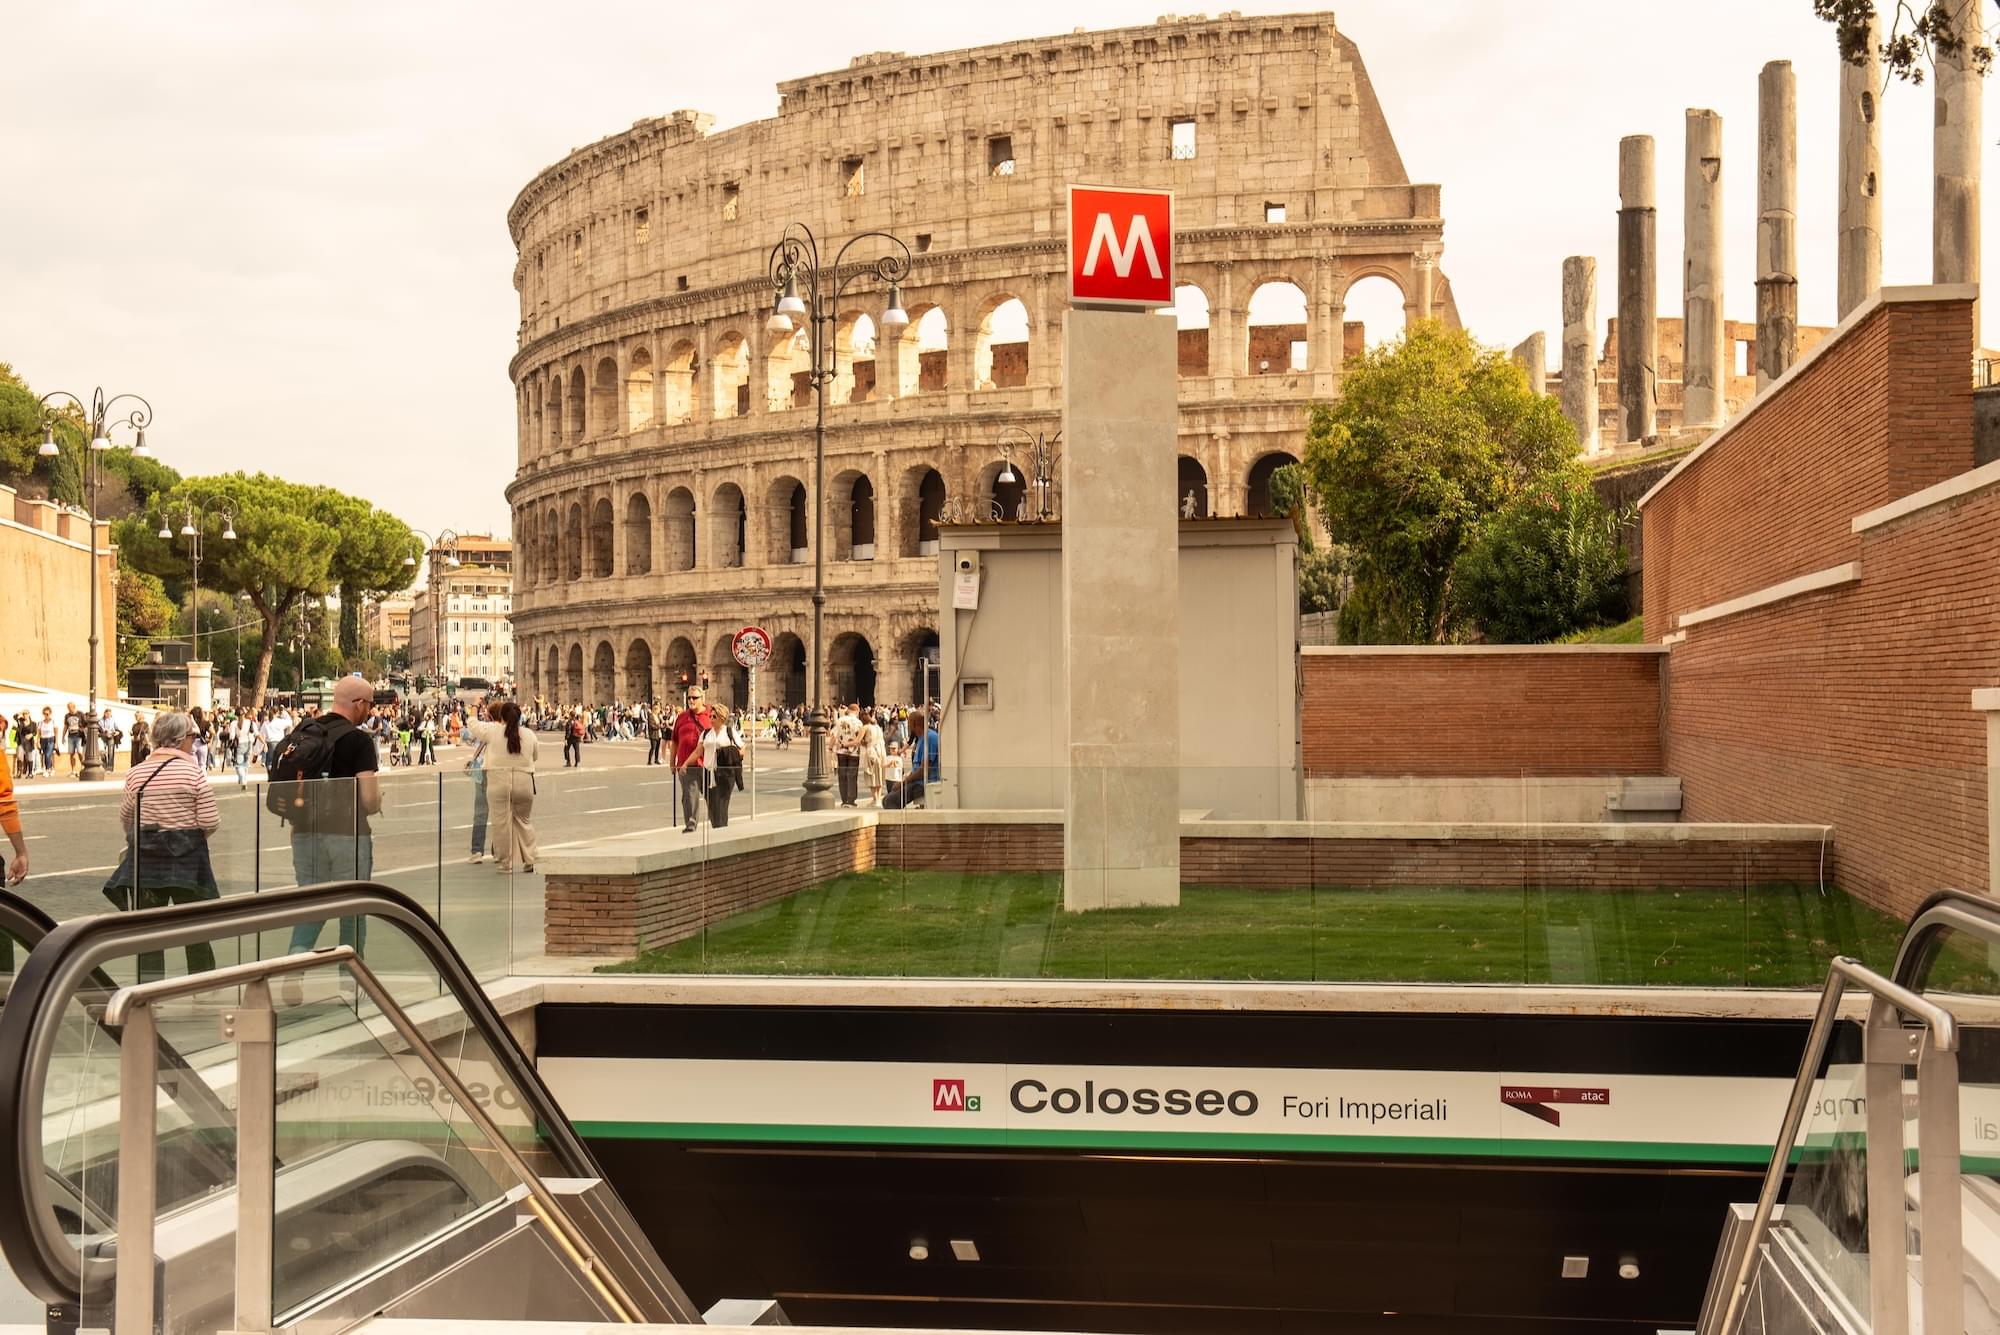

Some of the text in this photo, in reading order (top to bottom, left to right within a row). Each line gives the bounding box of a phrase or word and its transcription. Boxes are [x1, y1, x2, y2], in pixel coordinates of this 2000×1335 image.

[1082, 213, 1163, 279] M
[935, 1084, 963, 1106] M
[1010, 1079, 1448, 1124] Colosseo Fori Imperiali
[1505, 1090, 1605, 1102] ROMA atac
